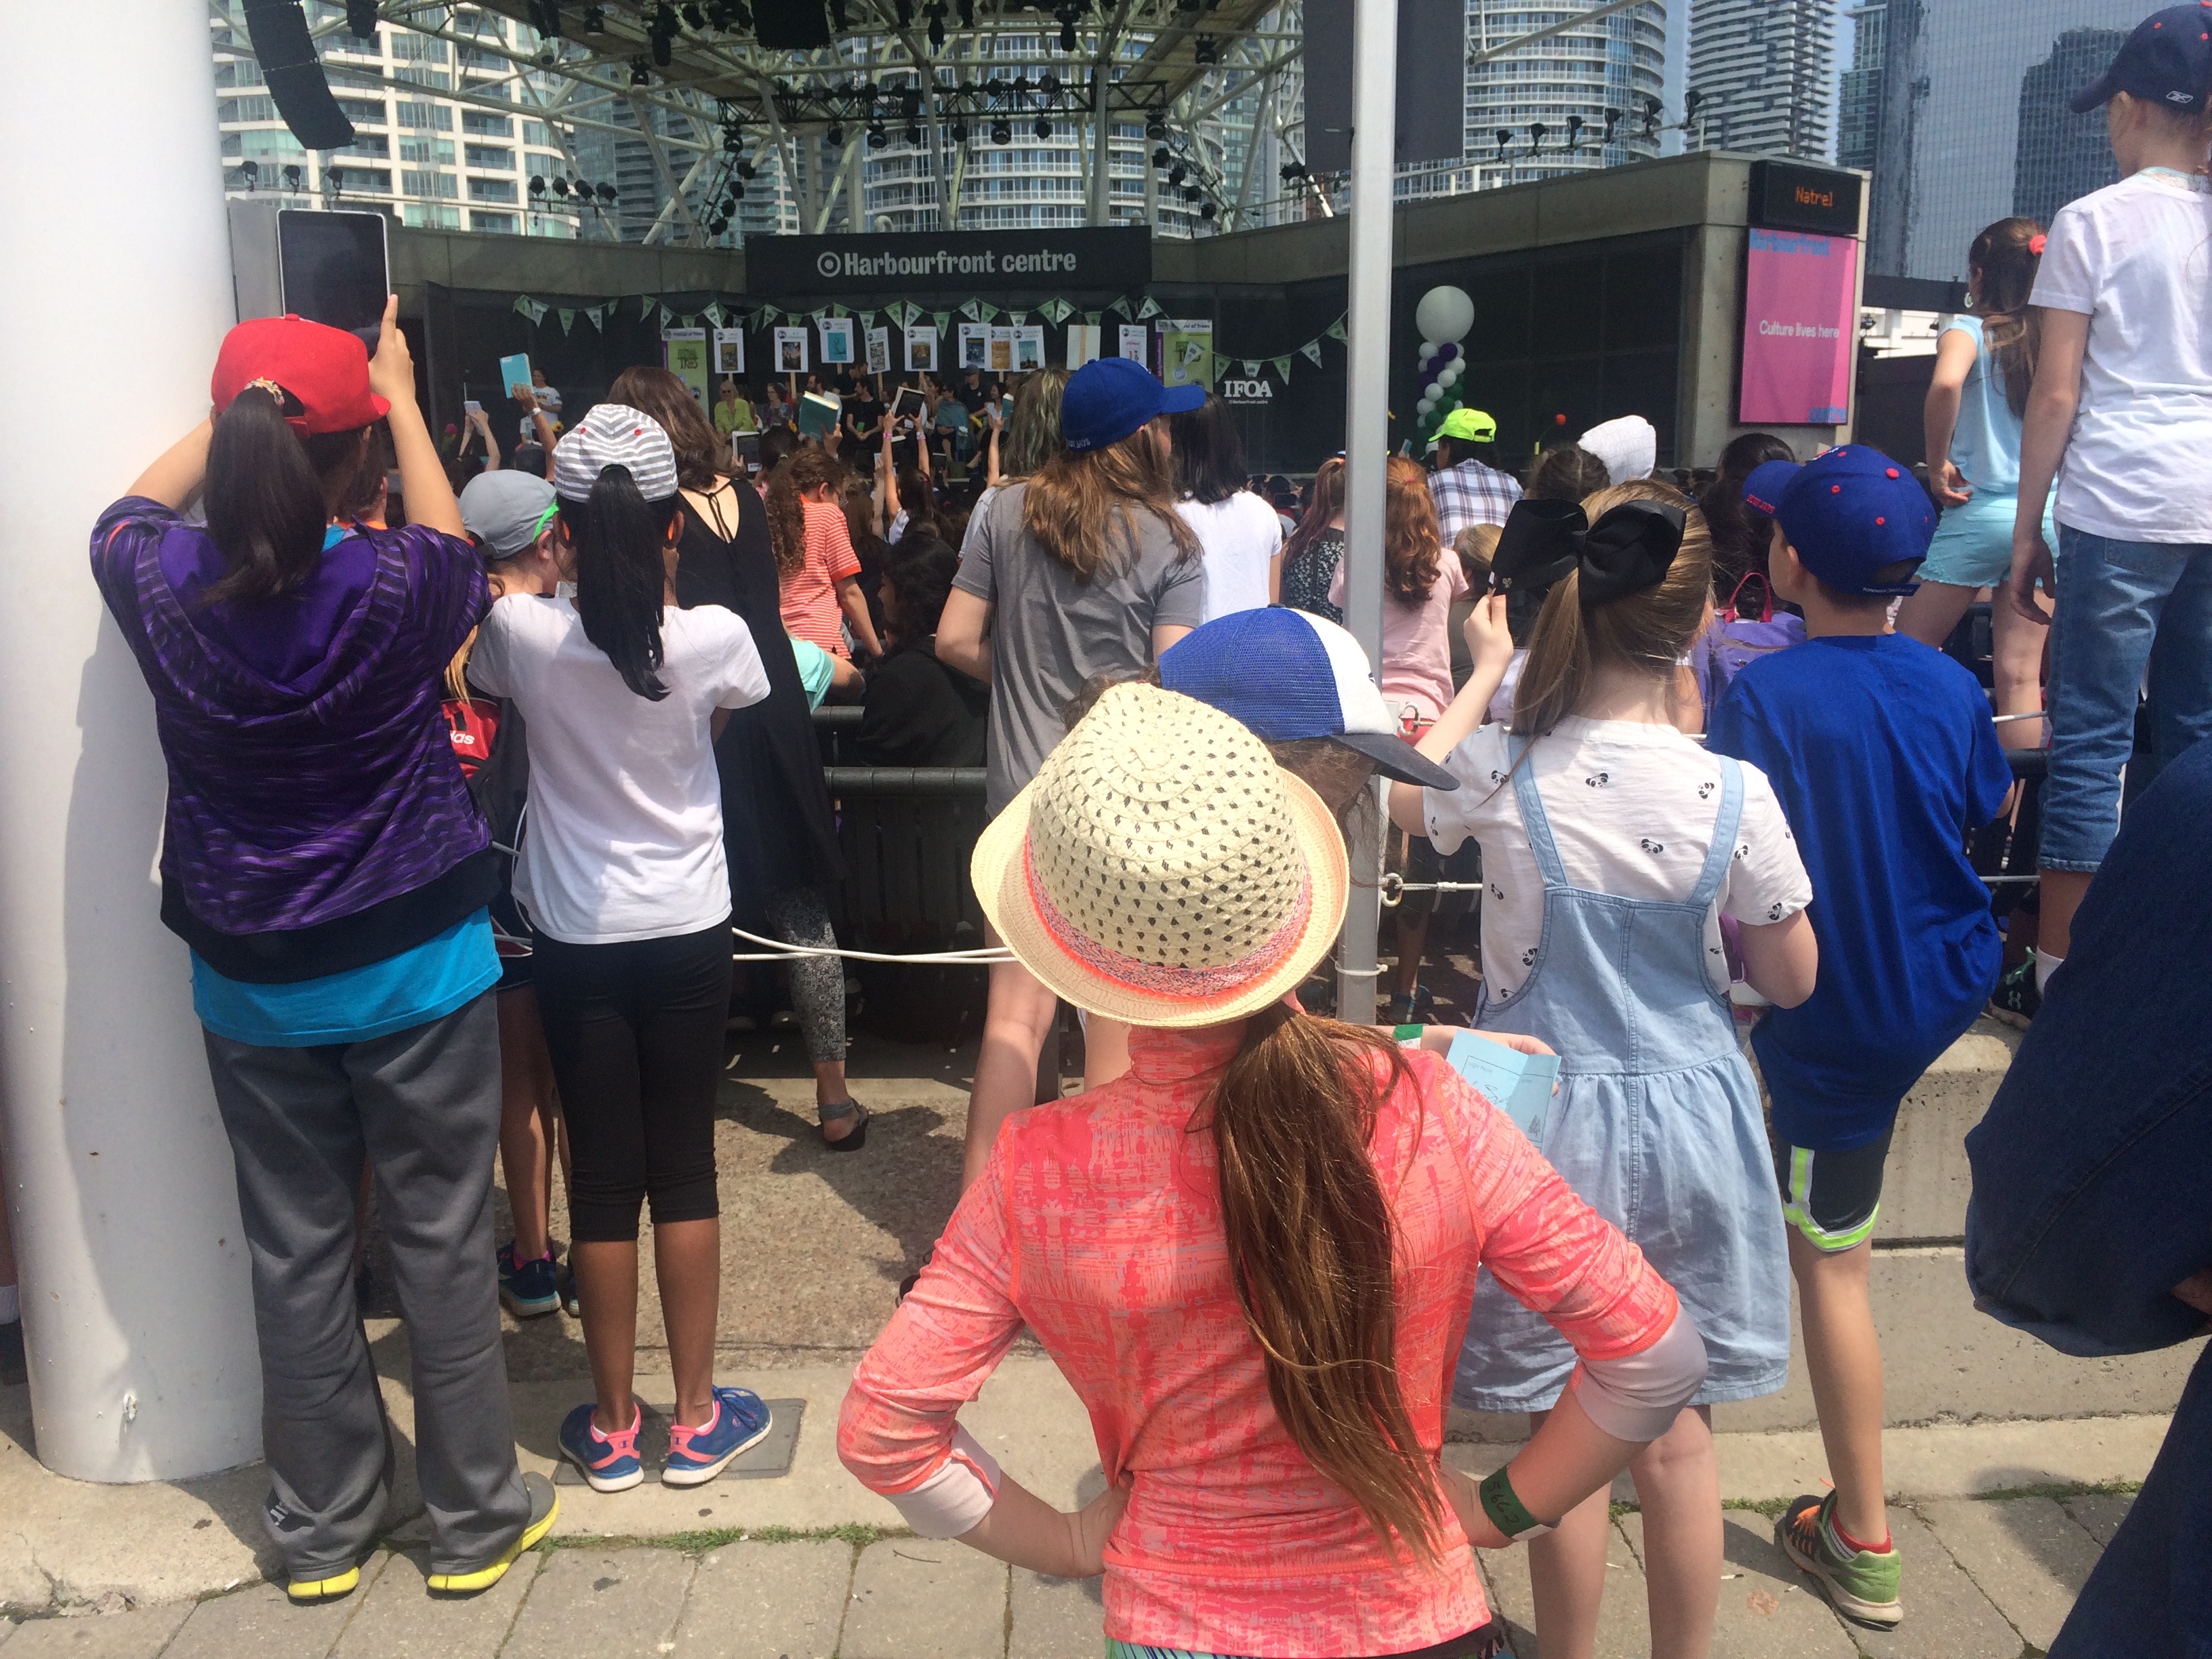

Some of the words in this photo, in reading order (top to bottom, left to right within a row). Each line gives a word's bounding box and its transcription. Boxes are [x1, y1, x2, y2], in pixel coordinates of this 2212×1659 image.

[1795, 186, 1833, 207] Natrel
[844, 251, 996, 276] Harbourfront
[1002, 249, 1077, 272] centre
[1759, 319, 1795, 336] Culture
[1795, 322, 1817, 337] lives
[1818, 323, 1840, 338] here
[1224, 380, 1273, 398] IFOA
